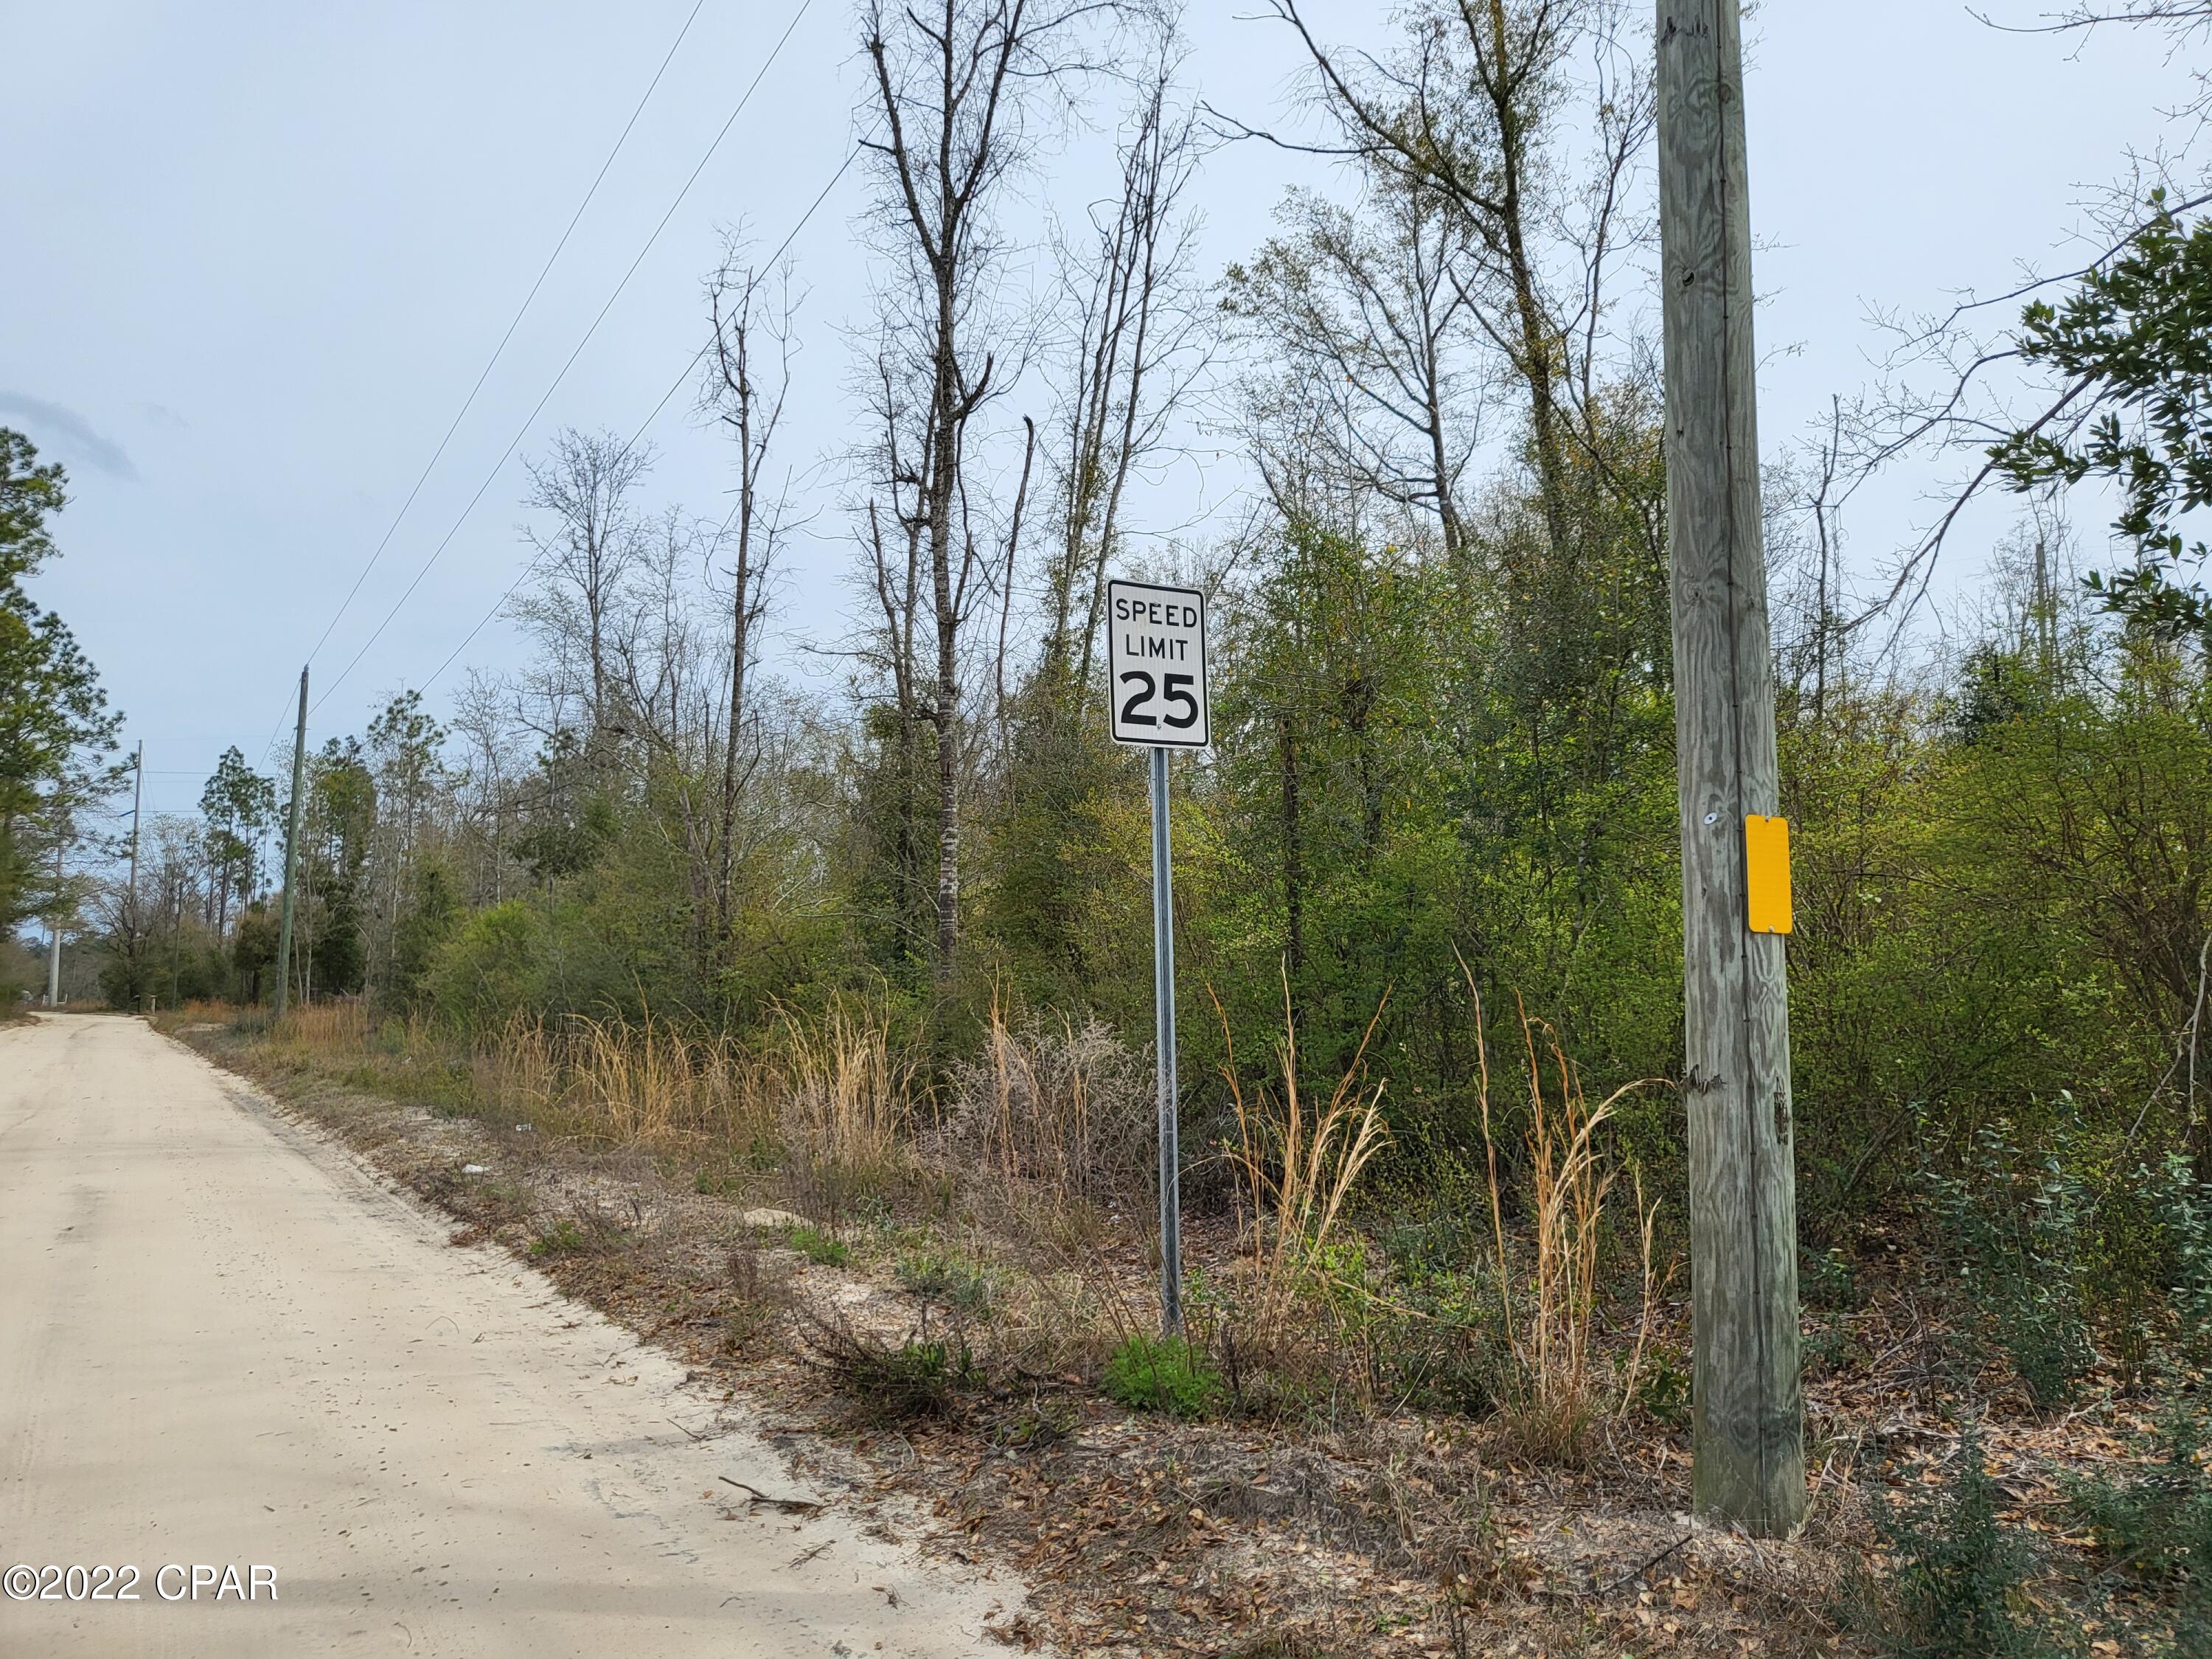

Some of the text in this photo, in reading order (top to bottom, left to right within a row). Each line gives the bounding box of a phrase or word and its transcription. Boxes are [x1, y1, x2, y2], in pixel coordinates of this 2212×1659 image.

[1116, 598, 1197, 628] SPEED
[1126, 633, 1188, 661] LIMIT
[1119, 670, 1199, 728] 25
